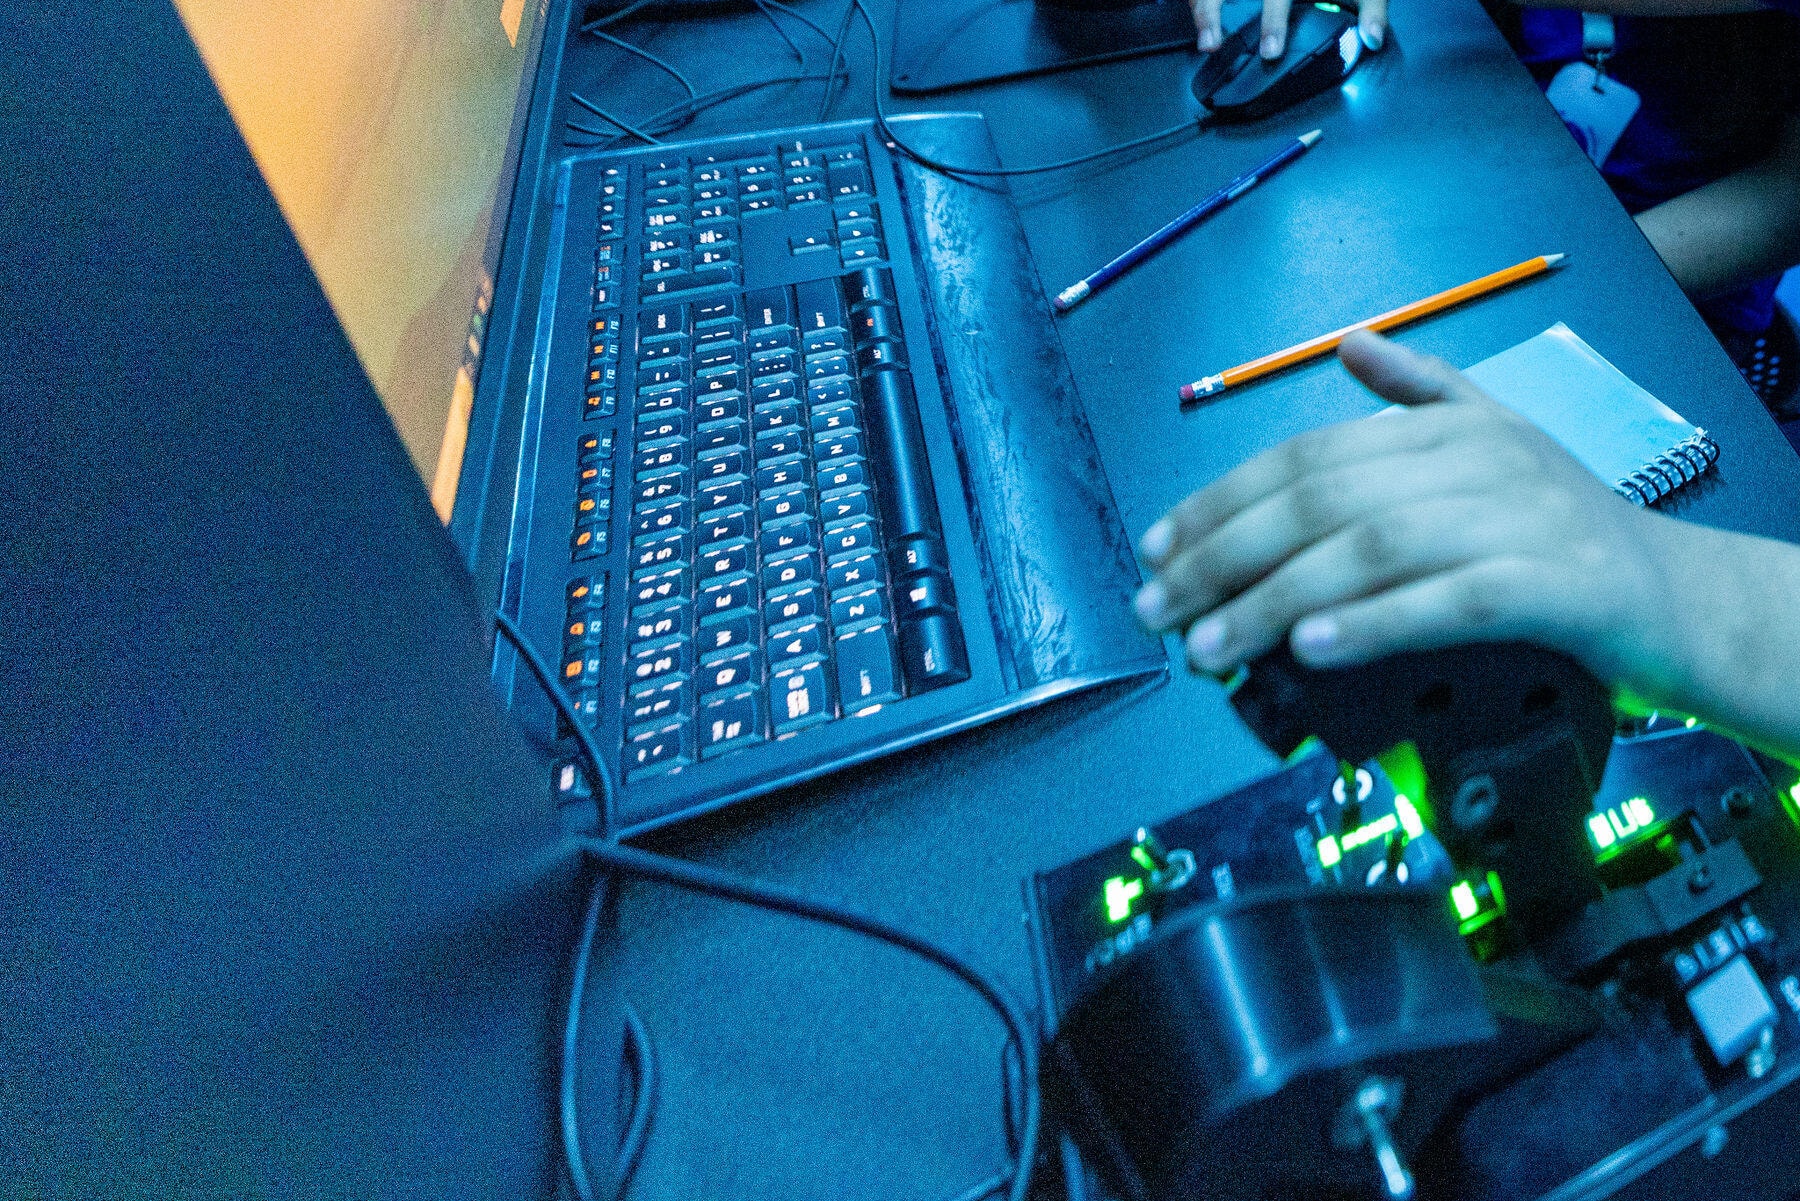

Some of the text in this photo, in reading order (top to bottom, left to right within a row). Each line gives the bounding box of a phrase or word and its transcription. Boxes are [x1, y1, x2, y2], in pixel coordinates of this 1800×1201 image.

[769, 389, 780, 397] L
[660, 397, 672, 406] 0
[770, 416, 782, 424] K
[828, 417, 839, 426] M
[660, 425, 672, 433] 9
[831, 444, 842, 454] N
[659, 453, 672, 463] 8
[713, 463, 726, 473] U
[774, 472, 786, 482] H
[834, 473, 847, 483] B
[658, 485, 671, 493] 7
[714, 496, 727, 504] Y
[776, 502, 790, 513] G
[838, 505, 850, 514] V
[658, 515, 672, 525] 6
[714, 527, 728, 537] T
[779, 537, 793, 545] F
[842, 536, 855, 547] C
[657, 548, 672, 559] 5
[715, 559, 729, 571] R
[781, 568, 795, 581] D
[846, 569, 859, 581] X
[657, 583, 671, 594] 4
[716, 594, 731, 607] E
[784, 603, 799, 616] S
[850, 604, 864, 616] Z
[655, 619, 671, 633] 3
[717, 631, 731, 646] W
[787, 639, 801, 652] A
[654, 657, 671, 672] 2
[717, 669, 735, 685] Q
[654, 700, 670, 711] 1
